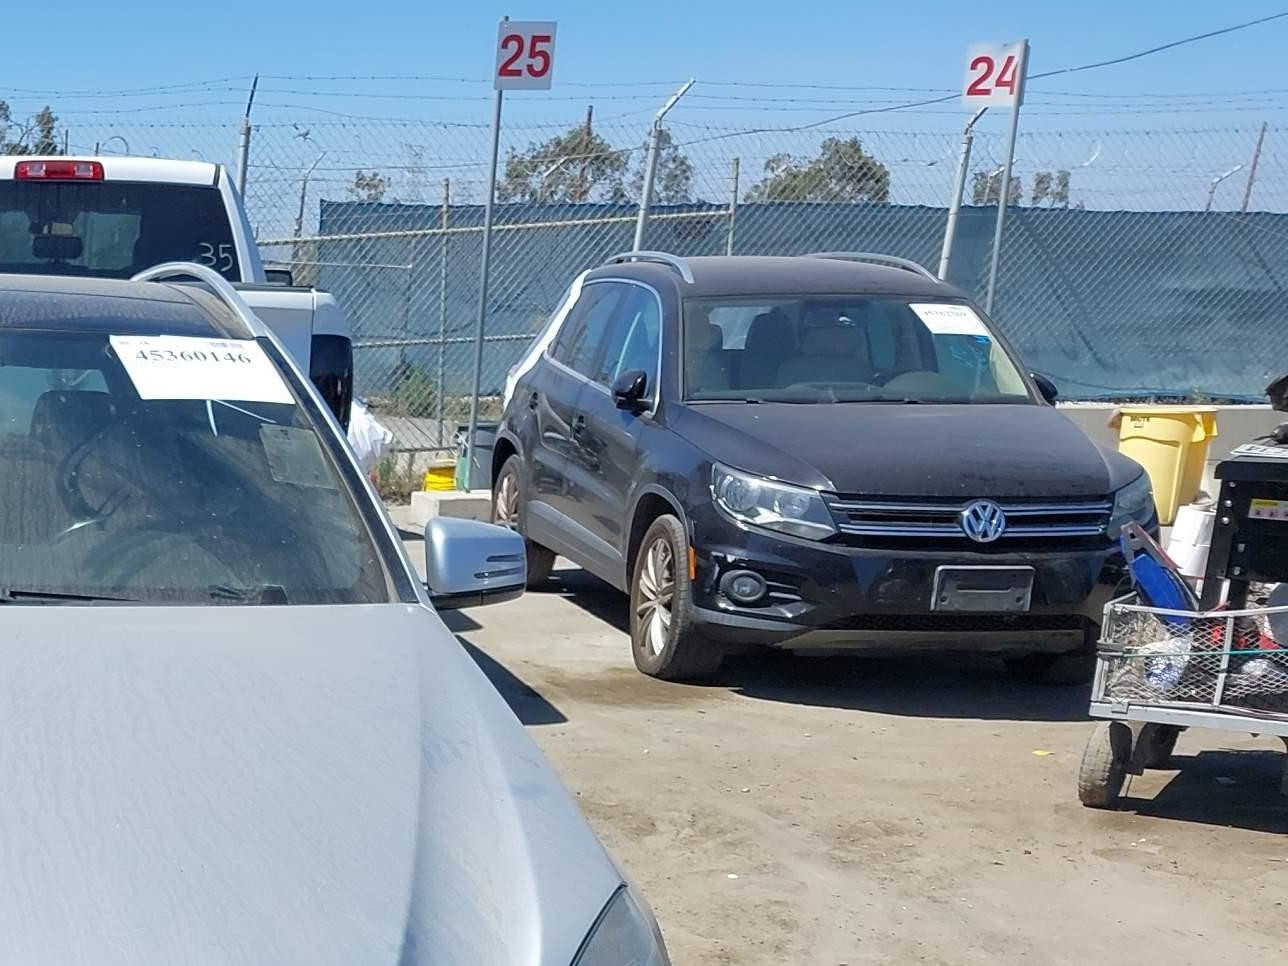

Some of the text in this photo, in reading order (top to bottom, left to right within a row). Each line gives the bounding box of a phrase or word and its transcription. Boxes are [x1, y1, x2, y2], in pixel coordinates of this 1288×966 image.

[498, 34, 552, 77] 25
[967, 55, 1018, 96] 24
[199, 242, 233, 272] 35
[135, 349, 252, 364] 45360146
